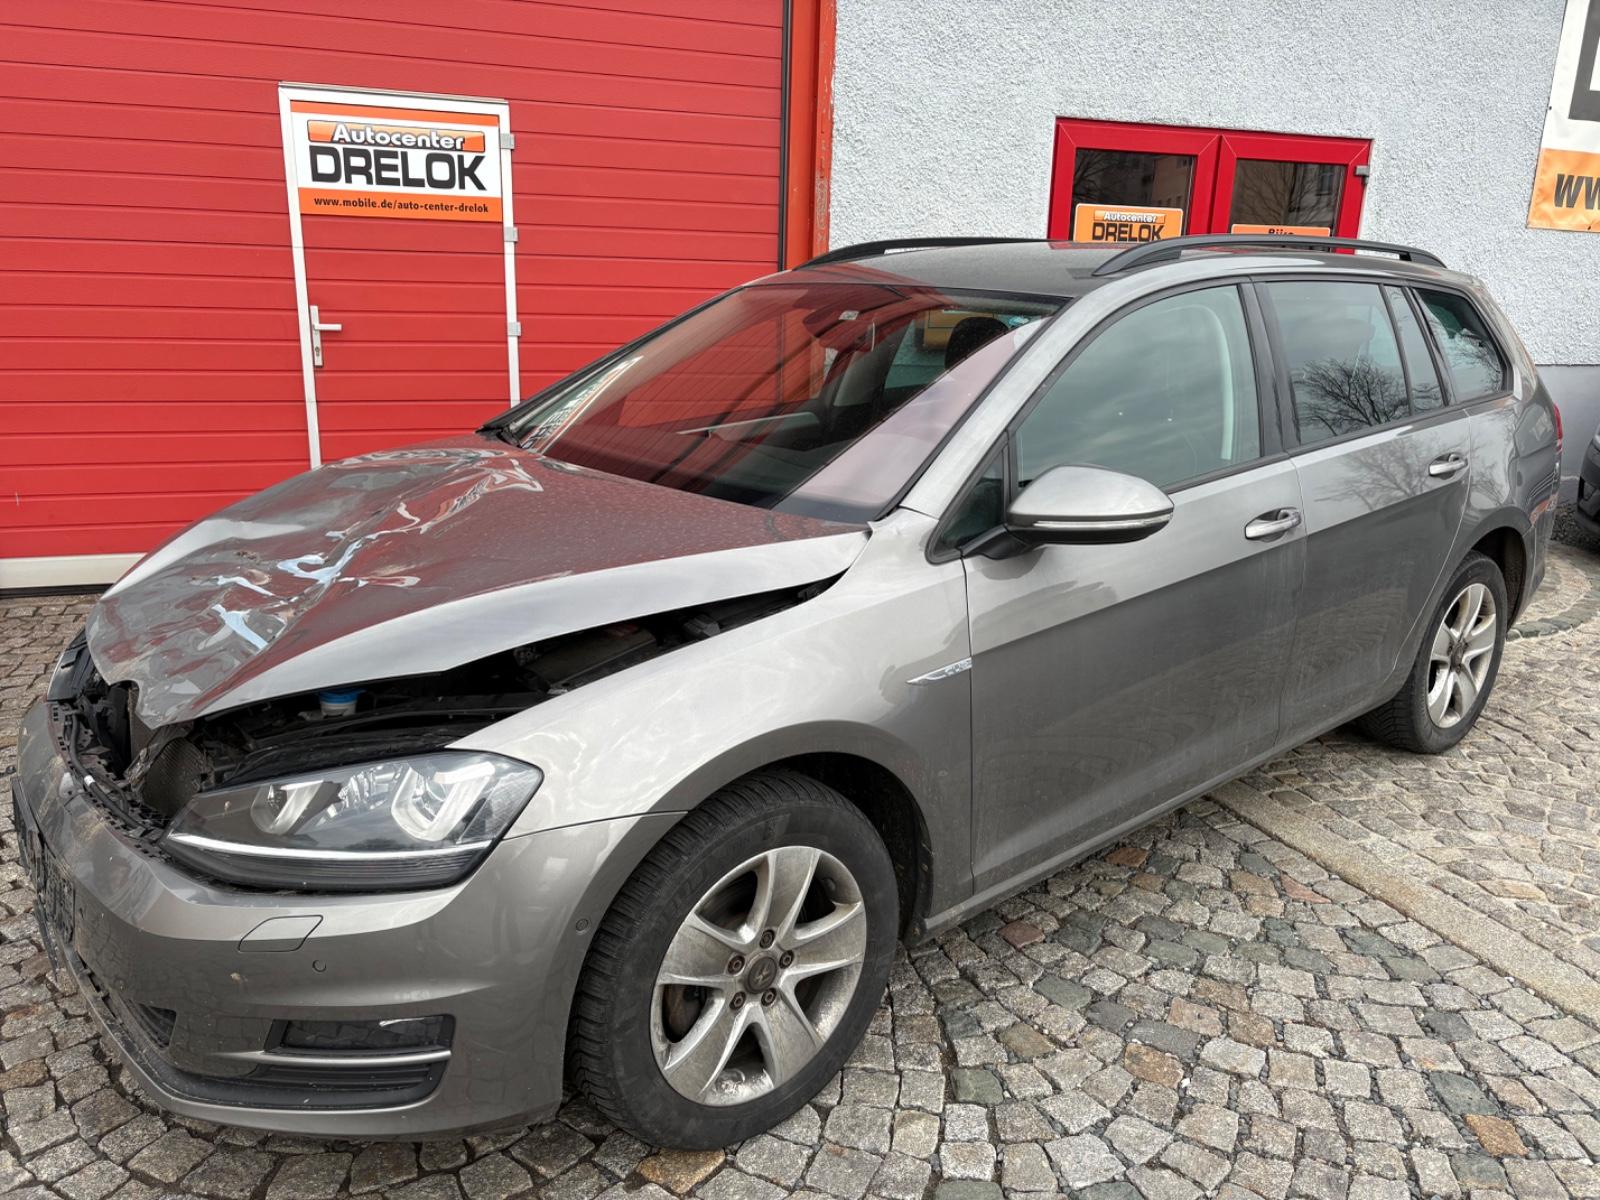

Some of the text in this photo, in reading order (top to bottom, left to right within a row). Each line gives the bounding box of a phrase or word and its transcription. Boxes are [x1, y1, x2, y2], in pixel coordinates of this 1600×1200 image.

[333, 125, 464, 149] Autocenter
[310, 146, 487, 190] DRELOK
[314, 197, 488, 213] www.mobile.de/auto-center-drelok
[1104, 212, 1156, 223] Autocenter
[1092, 222, 1164, 242] DRELOK
